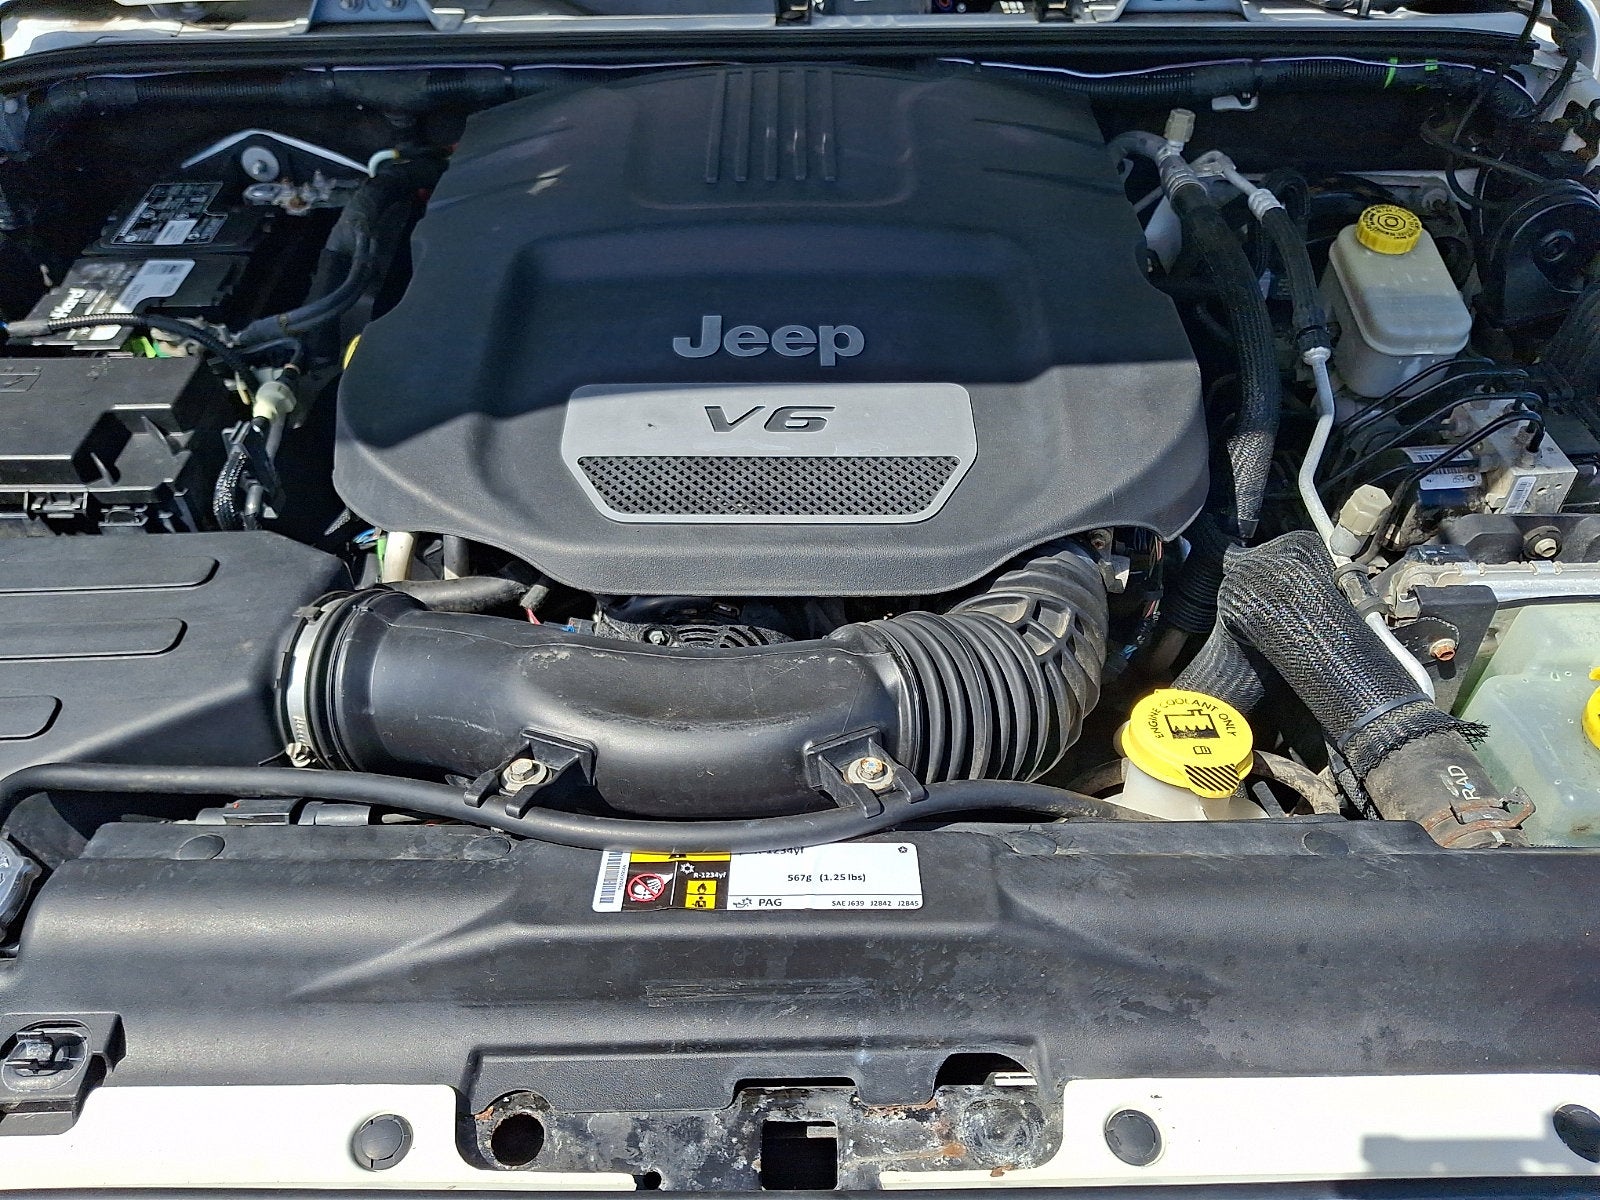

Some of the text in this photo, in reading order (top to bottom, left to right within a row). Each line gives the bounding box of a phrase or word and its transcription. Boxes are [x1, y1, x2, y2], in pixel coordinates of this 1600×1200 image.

[672, 315, 865, 367] Jeep
[704, 405, 836, 433] V6
[1148, 707, 1165, 739] ENGINE
[1218, 712, 1237, 737] ONLY
[1447, 765, 1481, 801] RAD
[693, 871, 727, 879] R-1234yf
[787, 873, 866, 882] 567g (1.25 lbs)
[758, 898, 782, 907] PAG
